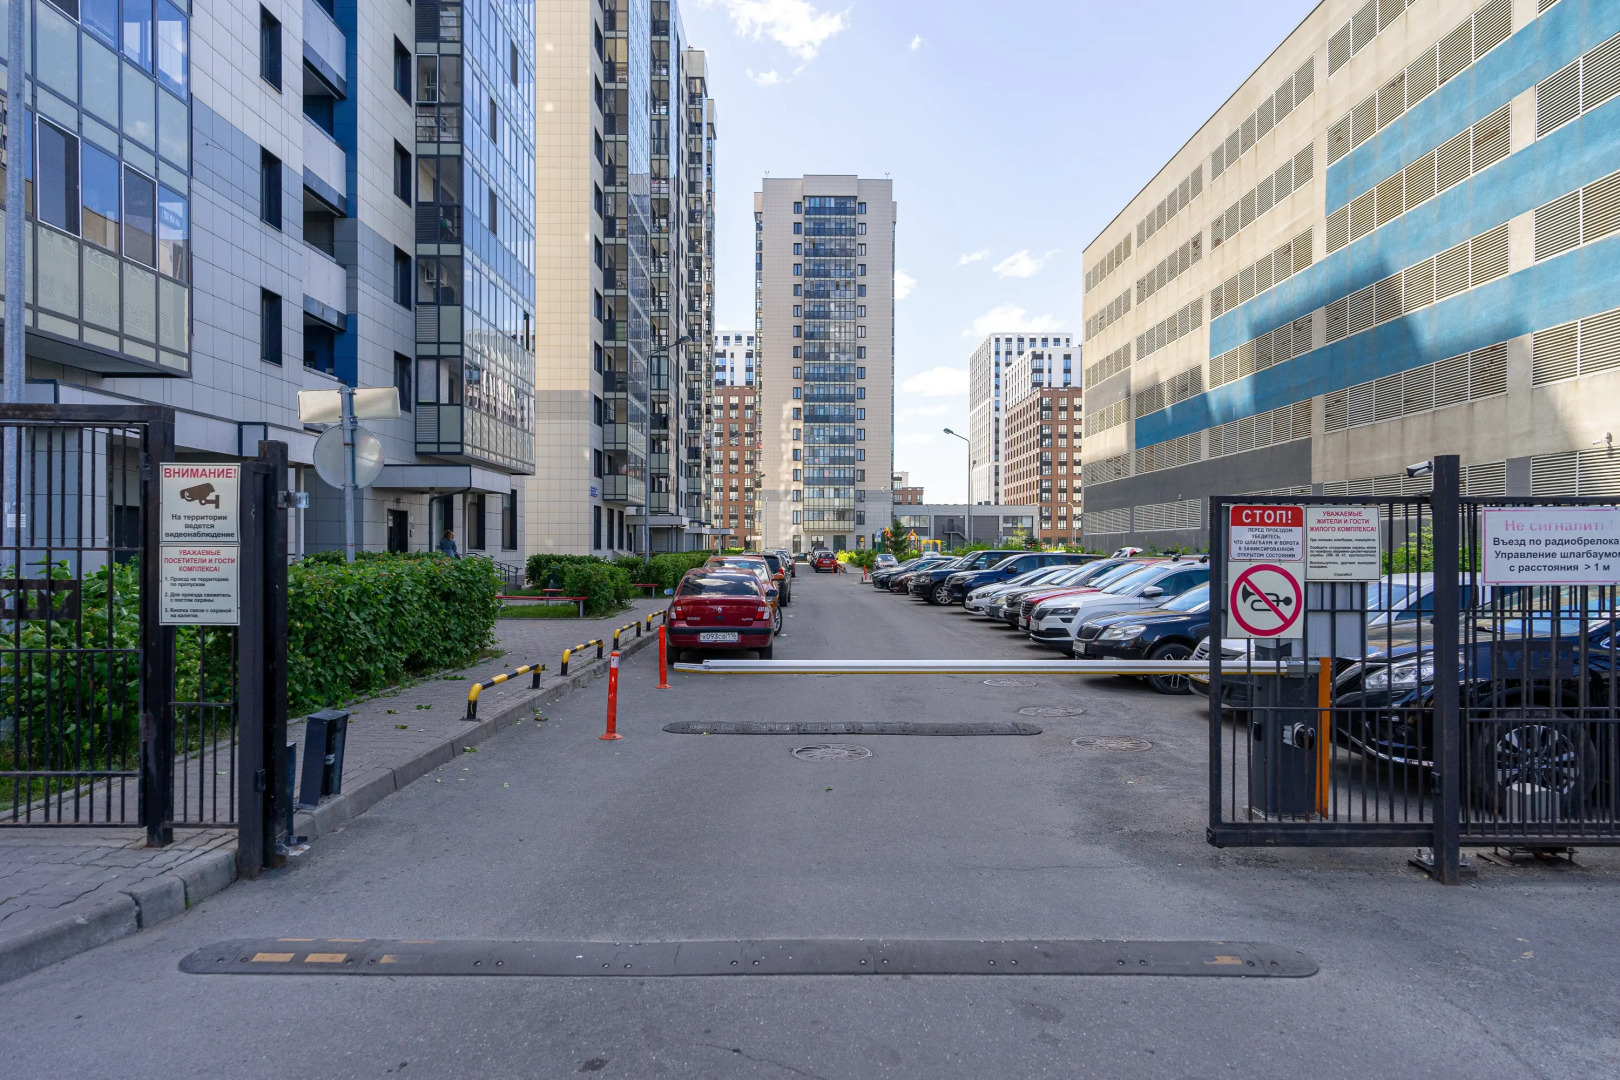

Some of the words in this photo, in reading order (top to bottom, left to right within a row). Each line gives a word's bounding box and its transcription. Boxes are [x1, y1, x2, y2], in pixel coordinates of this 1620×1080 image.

[164, 468, 236, 478] ВНИМАНИЕ!
[1242, 510, 1292, 524] СТОП!
[1505, 520, 1524, 531] Не
[1493, 538, 1526, 547] Въезд
[1494, 550, 1557, 560] Управление
[1518, 565, 1578, 573] расстояния
